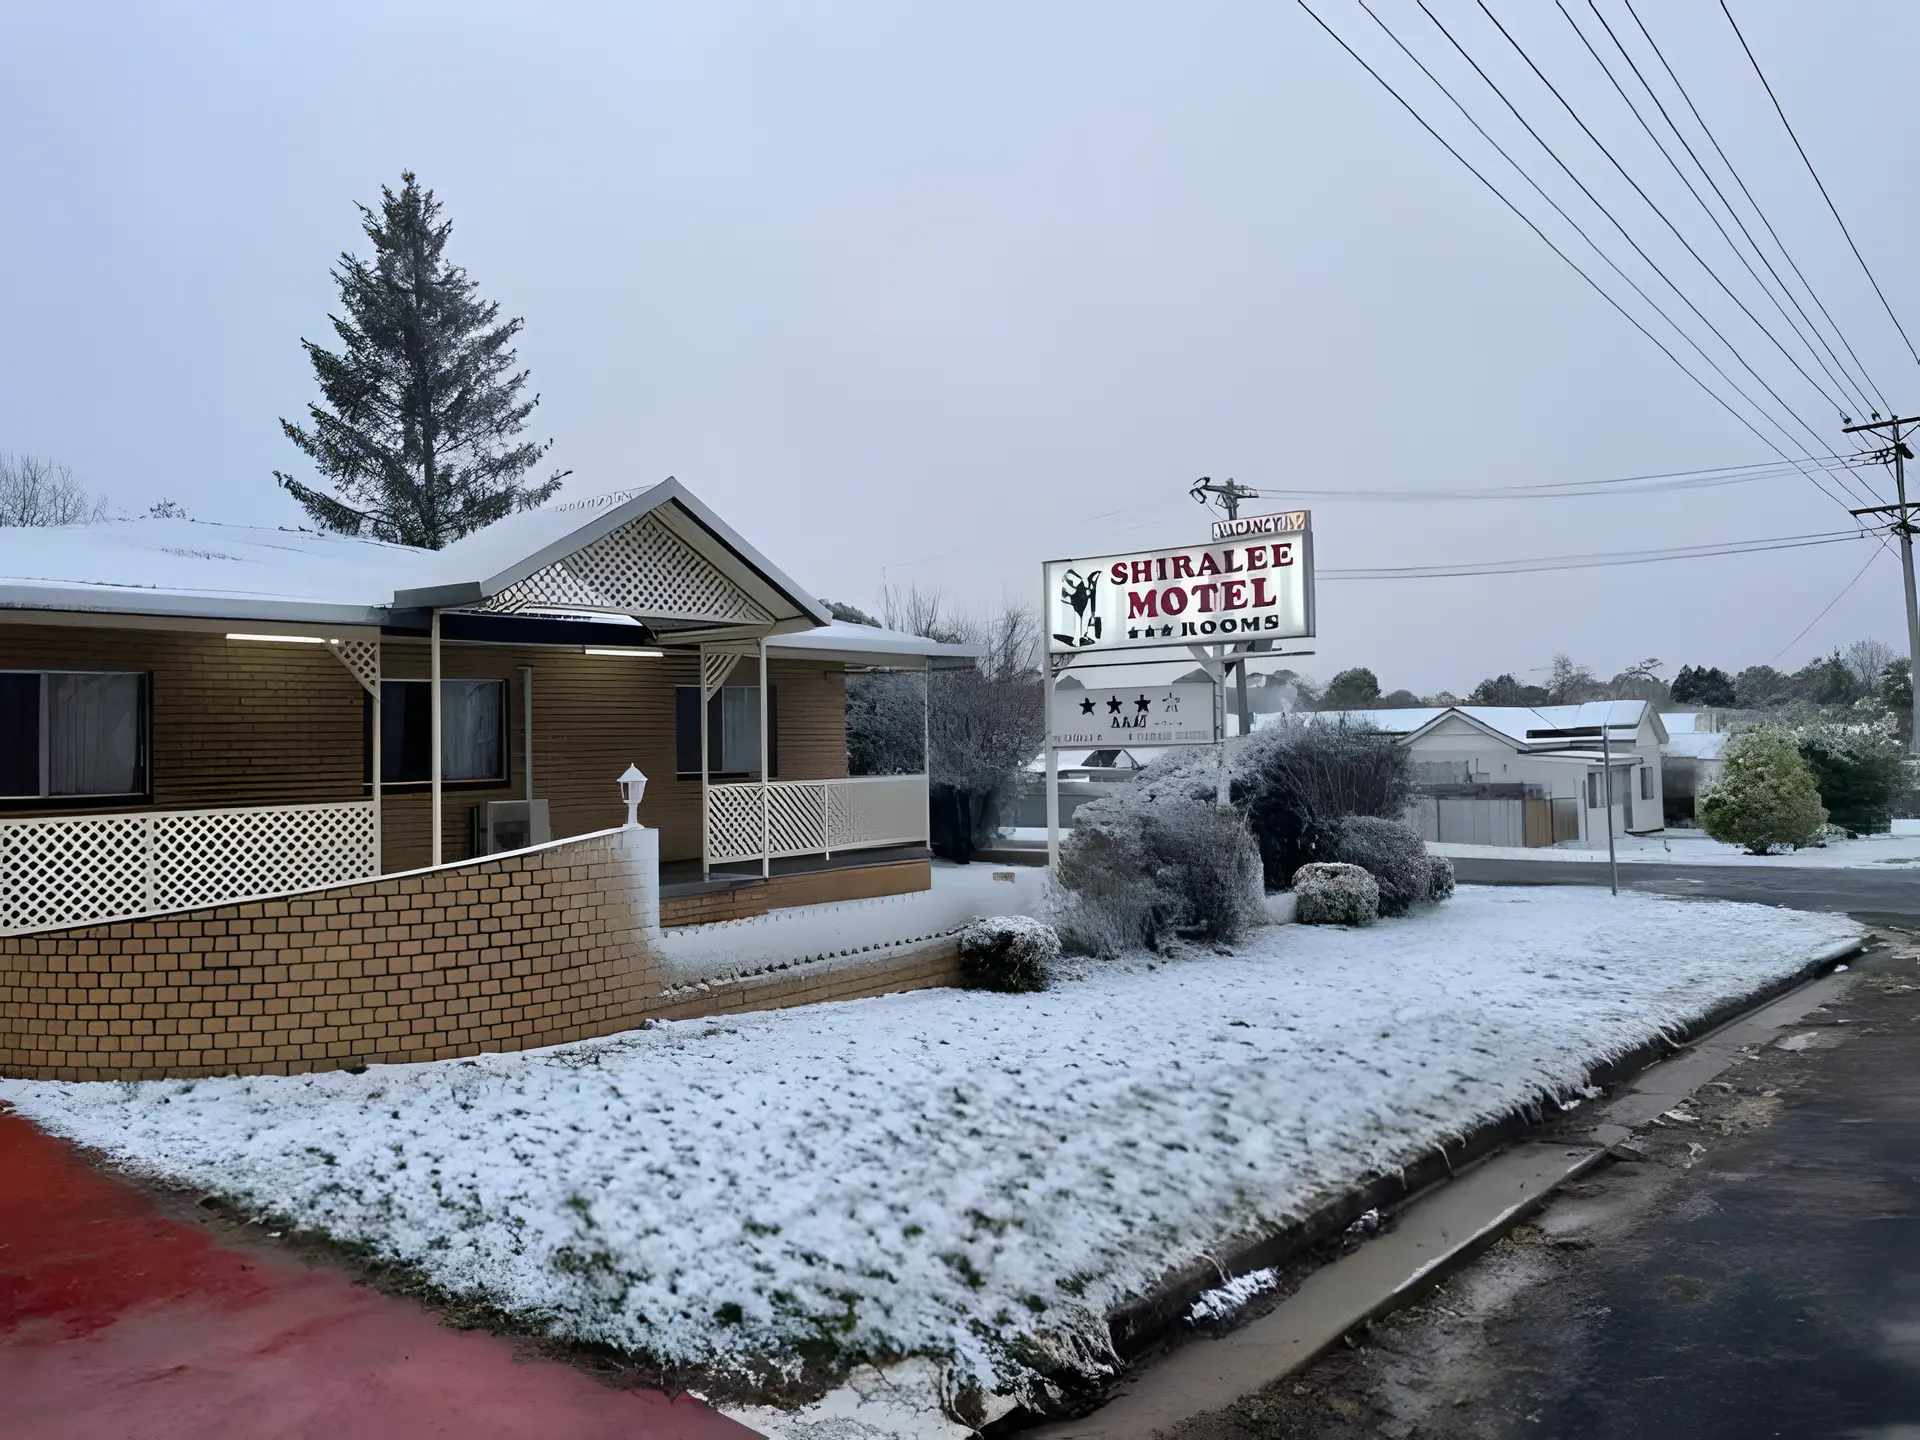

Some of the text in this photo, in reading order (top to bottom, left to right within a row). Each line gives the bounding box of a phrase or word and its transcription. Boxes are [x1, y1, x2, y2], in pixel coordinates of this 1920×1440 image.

[1110, 543, 1293, 585] SHIRALEE
[1127, 577, 1277, 619] MOTEL
[1181, 615, 1279, 636] ROOMS
